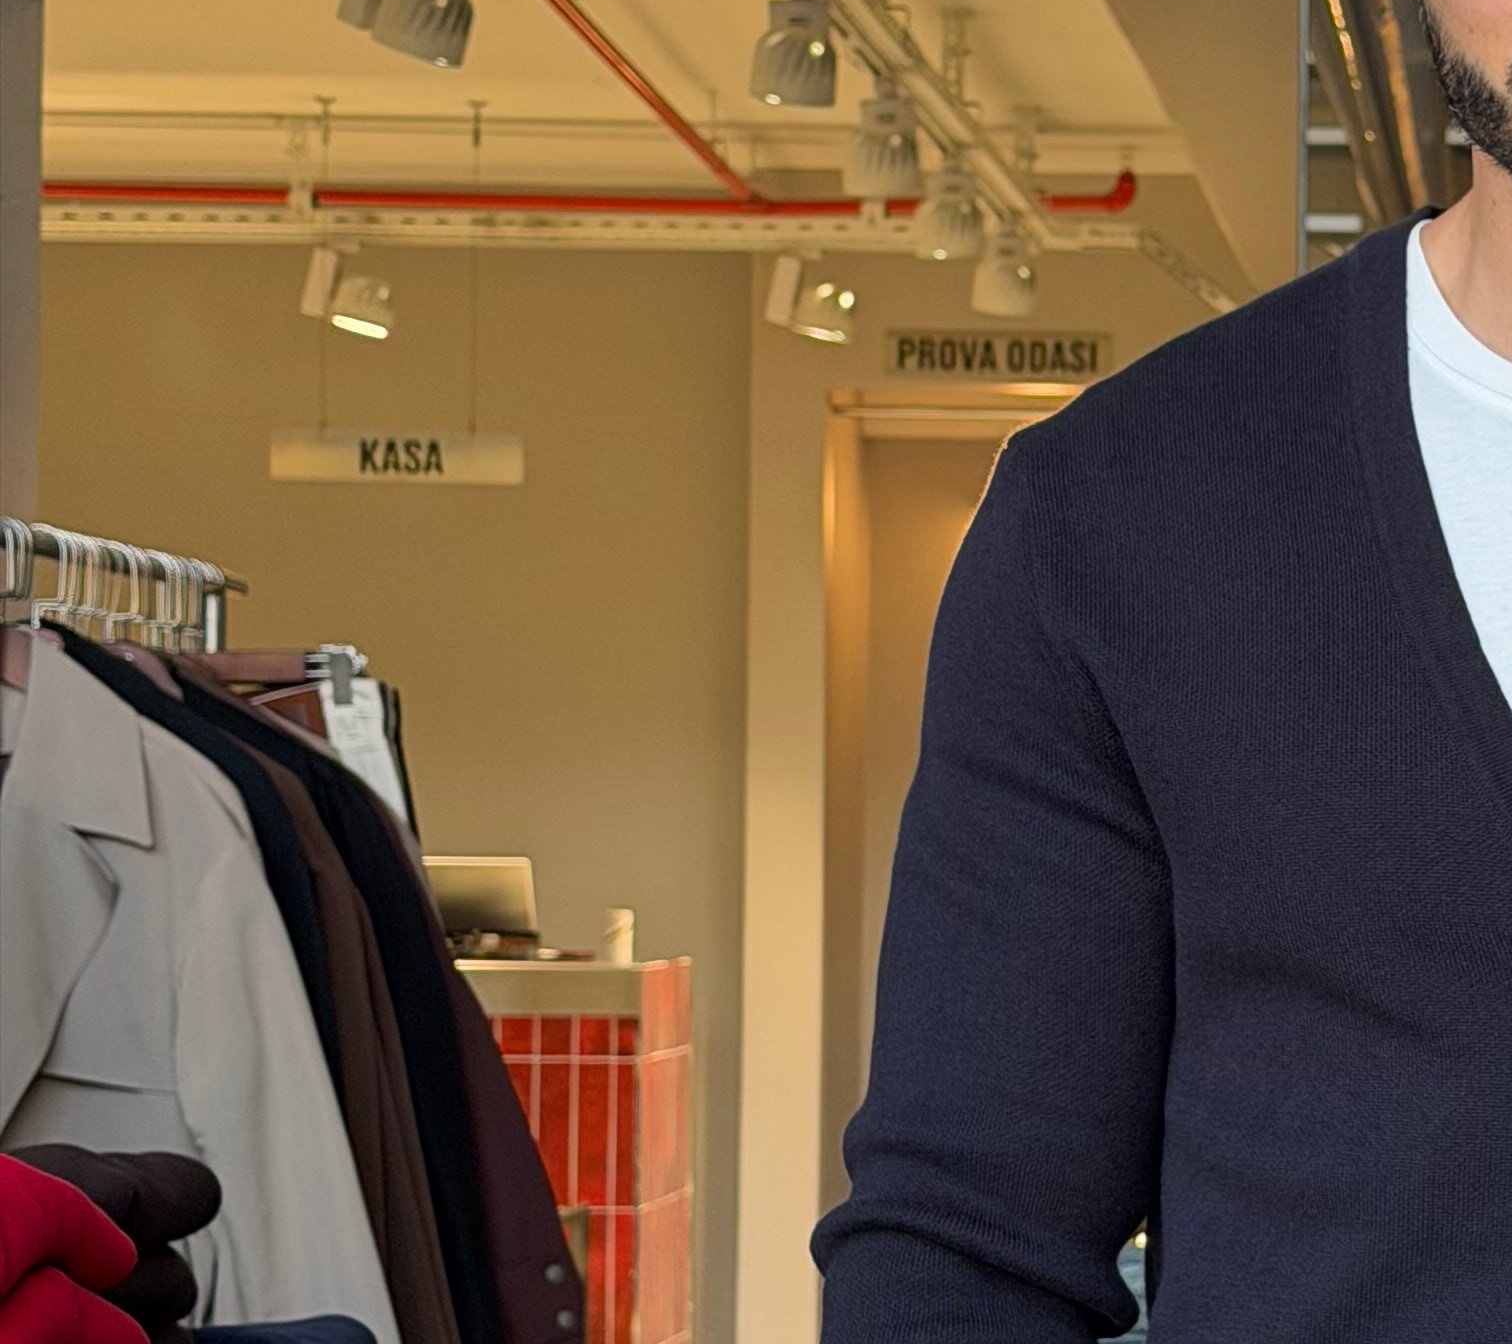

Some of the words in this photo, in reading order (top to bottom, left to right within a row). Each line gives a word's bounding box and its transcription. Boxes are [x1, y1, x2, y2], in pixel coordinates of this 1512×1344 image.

[897, 336, 997, 372] PROVA
[1006, 338, 1098, 373] ODASI
[359, 438, 444, 475] KASA
